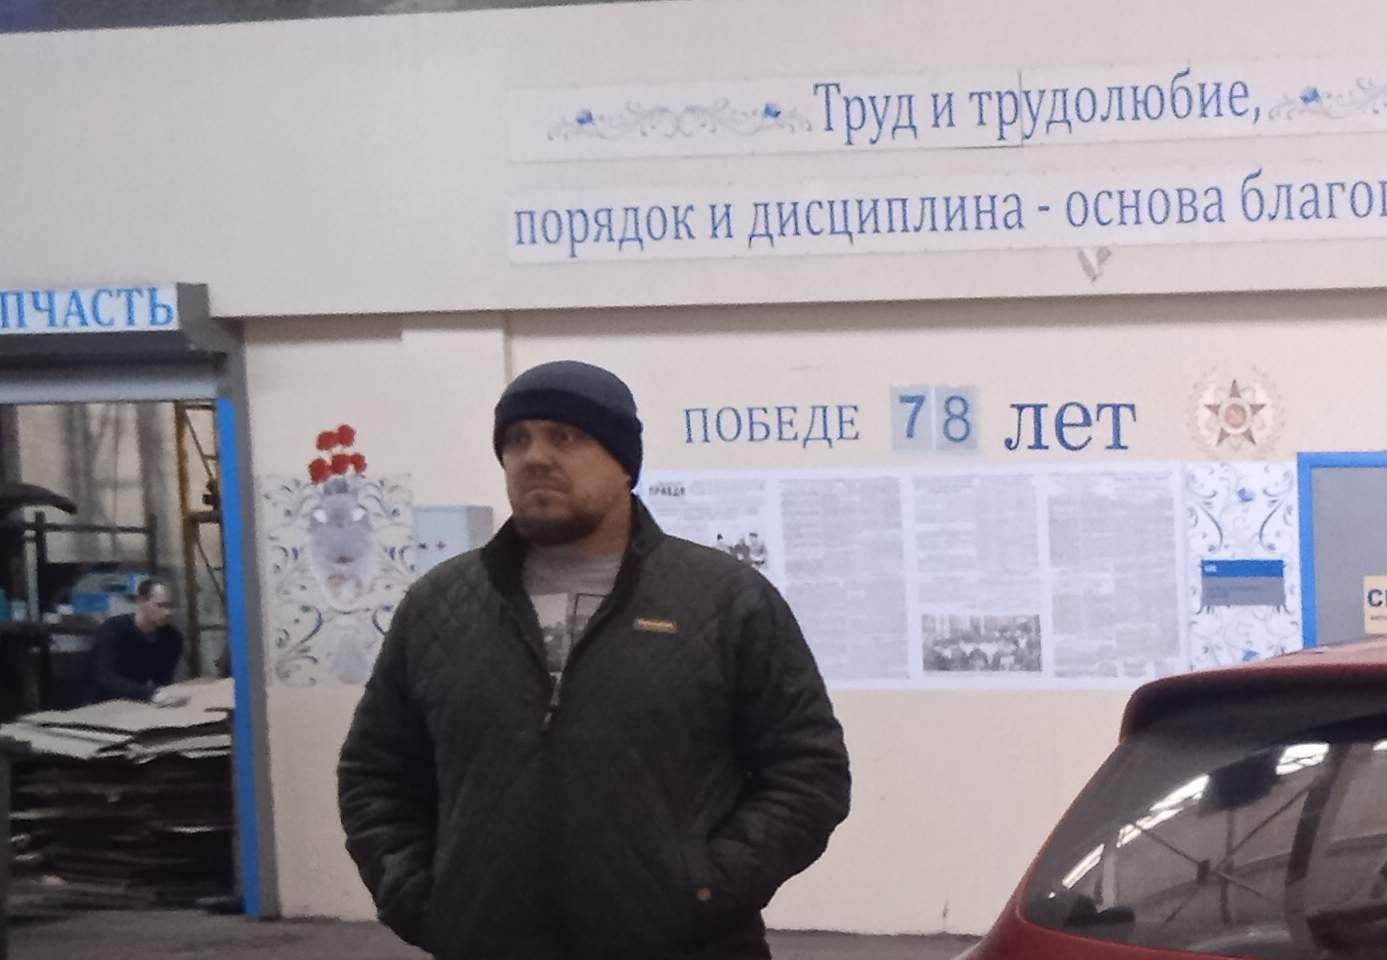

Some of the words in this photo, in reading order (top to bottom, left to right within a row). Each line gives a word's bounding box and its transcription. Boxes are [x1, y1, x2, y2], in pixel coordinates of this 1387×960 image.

[813, 82, 918, 145] Труд
[930, 91, 956, 128] и
[969, 67, 1261, 141] трудолюбие,
[514, 201, 696, 257] порядок
[708, 203, 734, 239] и
[747, 191, 1025, 248] дисциплина
[1066, 184, 1227, 228] основа
[684, 404, 861, 450] ПОБЕДЕ
[898, 394, 972, 445] 78
[1004, 400, 1138, 453] лет
